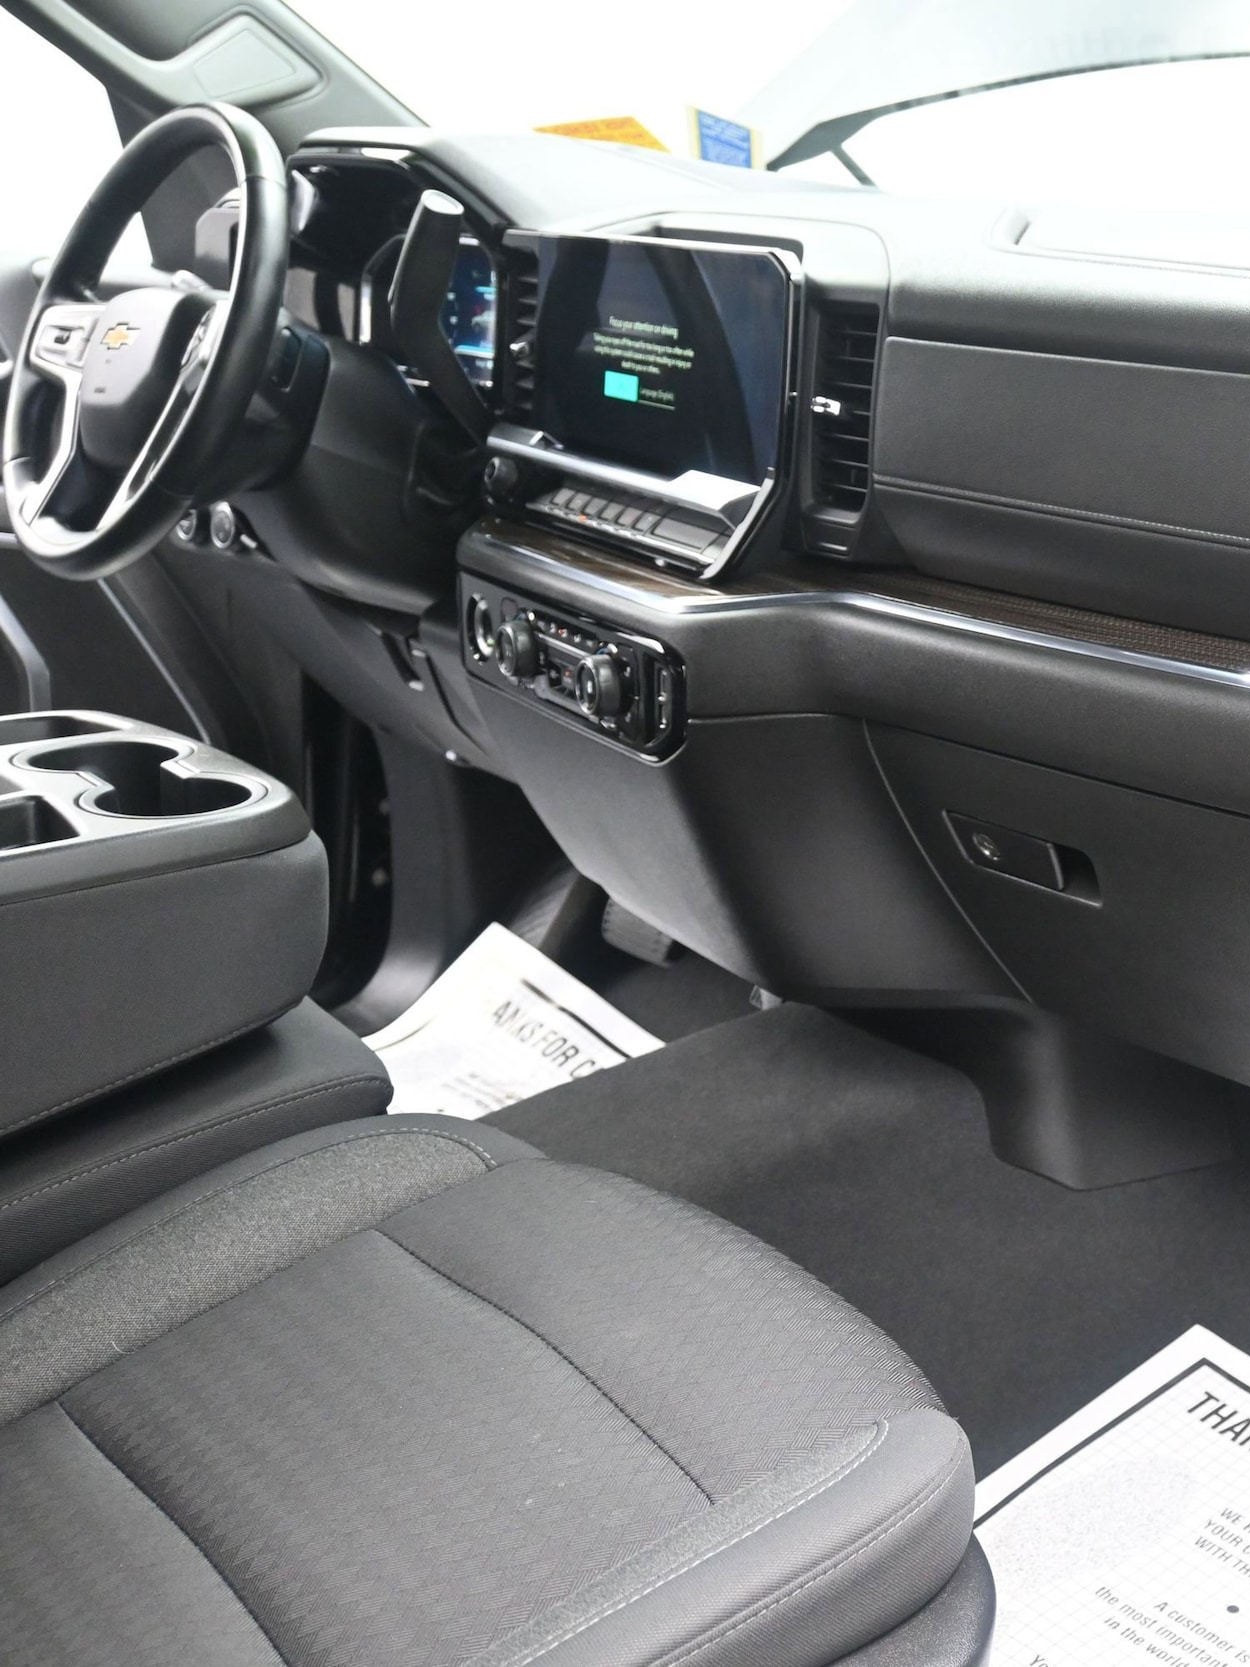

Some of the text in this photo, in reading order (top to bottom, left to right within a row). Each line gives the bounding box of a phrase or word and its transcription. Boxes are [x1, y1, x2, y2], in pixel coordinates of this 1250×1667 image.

[532, 1030, 579, 1067] FOR
[1220, 1507, 1243, 1525] WE
[1204, 1519, 1244, 1547] YOUR
[1194, 1536, 1233, 1562] WITH
[1095, 1586, 1119, 1605] the
[1119, 1604, 1158, 1629] most
[1103, 1617, 1121, 1630] in
[1120, 1627, 1145, 1646] the
[1153, 1601, 1250, 1663] A customer is
